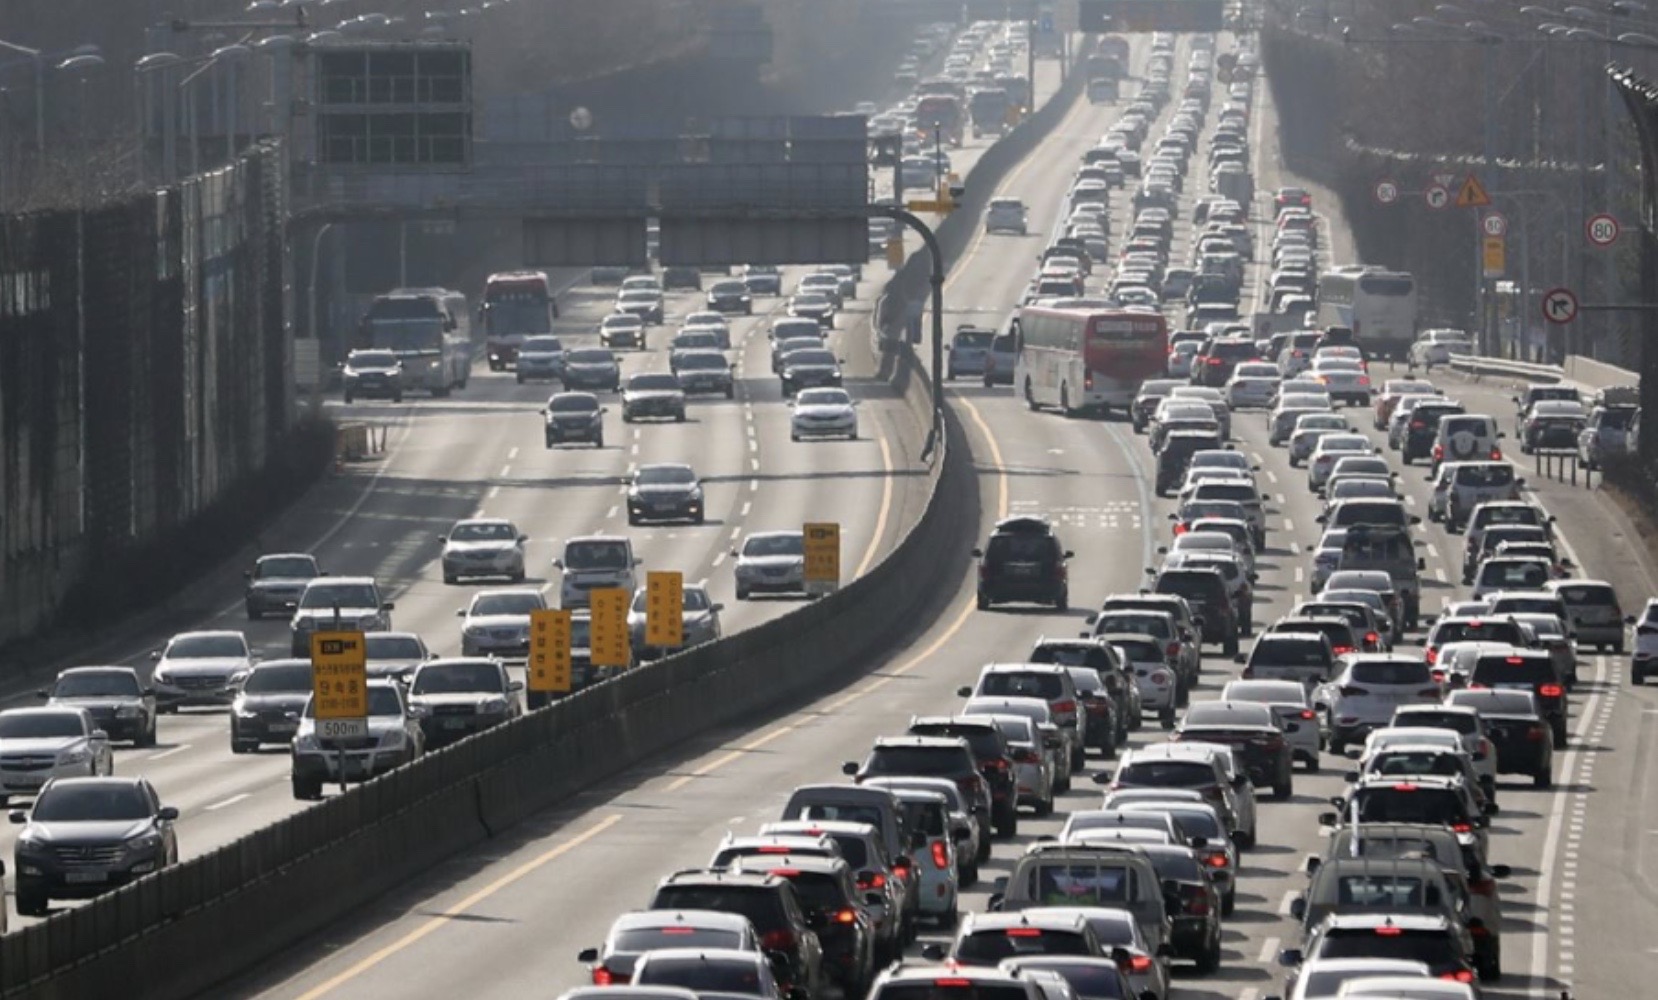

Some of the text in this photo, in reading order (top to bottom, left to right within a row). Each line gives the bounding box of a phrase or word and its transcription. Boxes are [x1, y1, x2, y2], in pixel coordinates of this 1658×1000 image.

[1380, 186, 1394, 199] 80
[1595, 222, 1613, 239] 80
[324, 721, 359, 735] 500m
